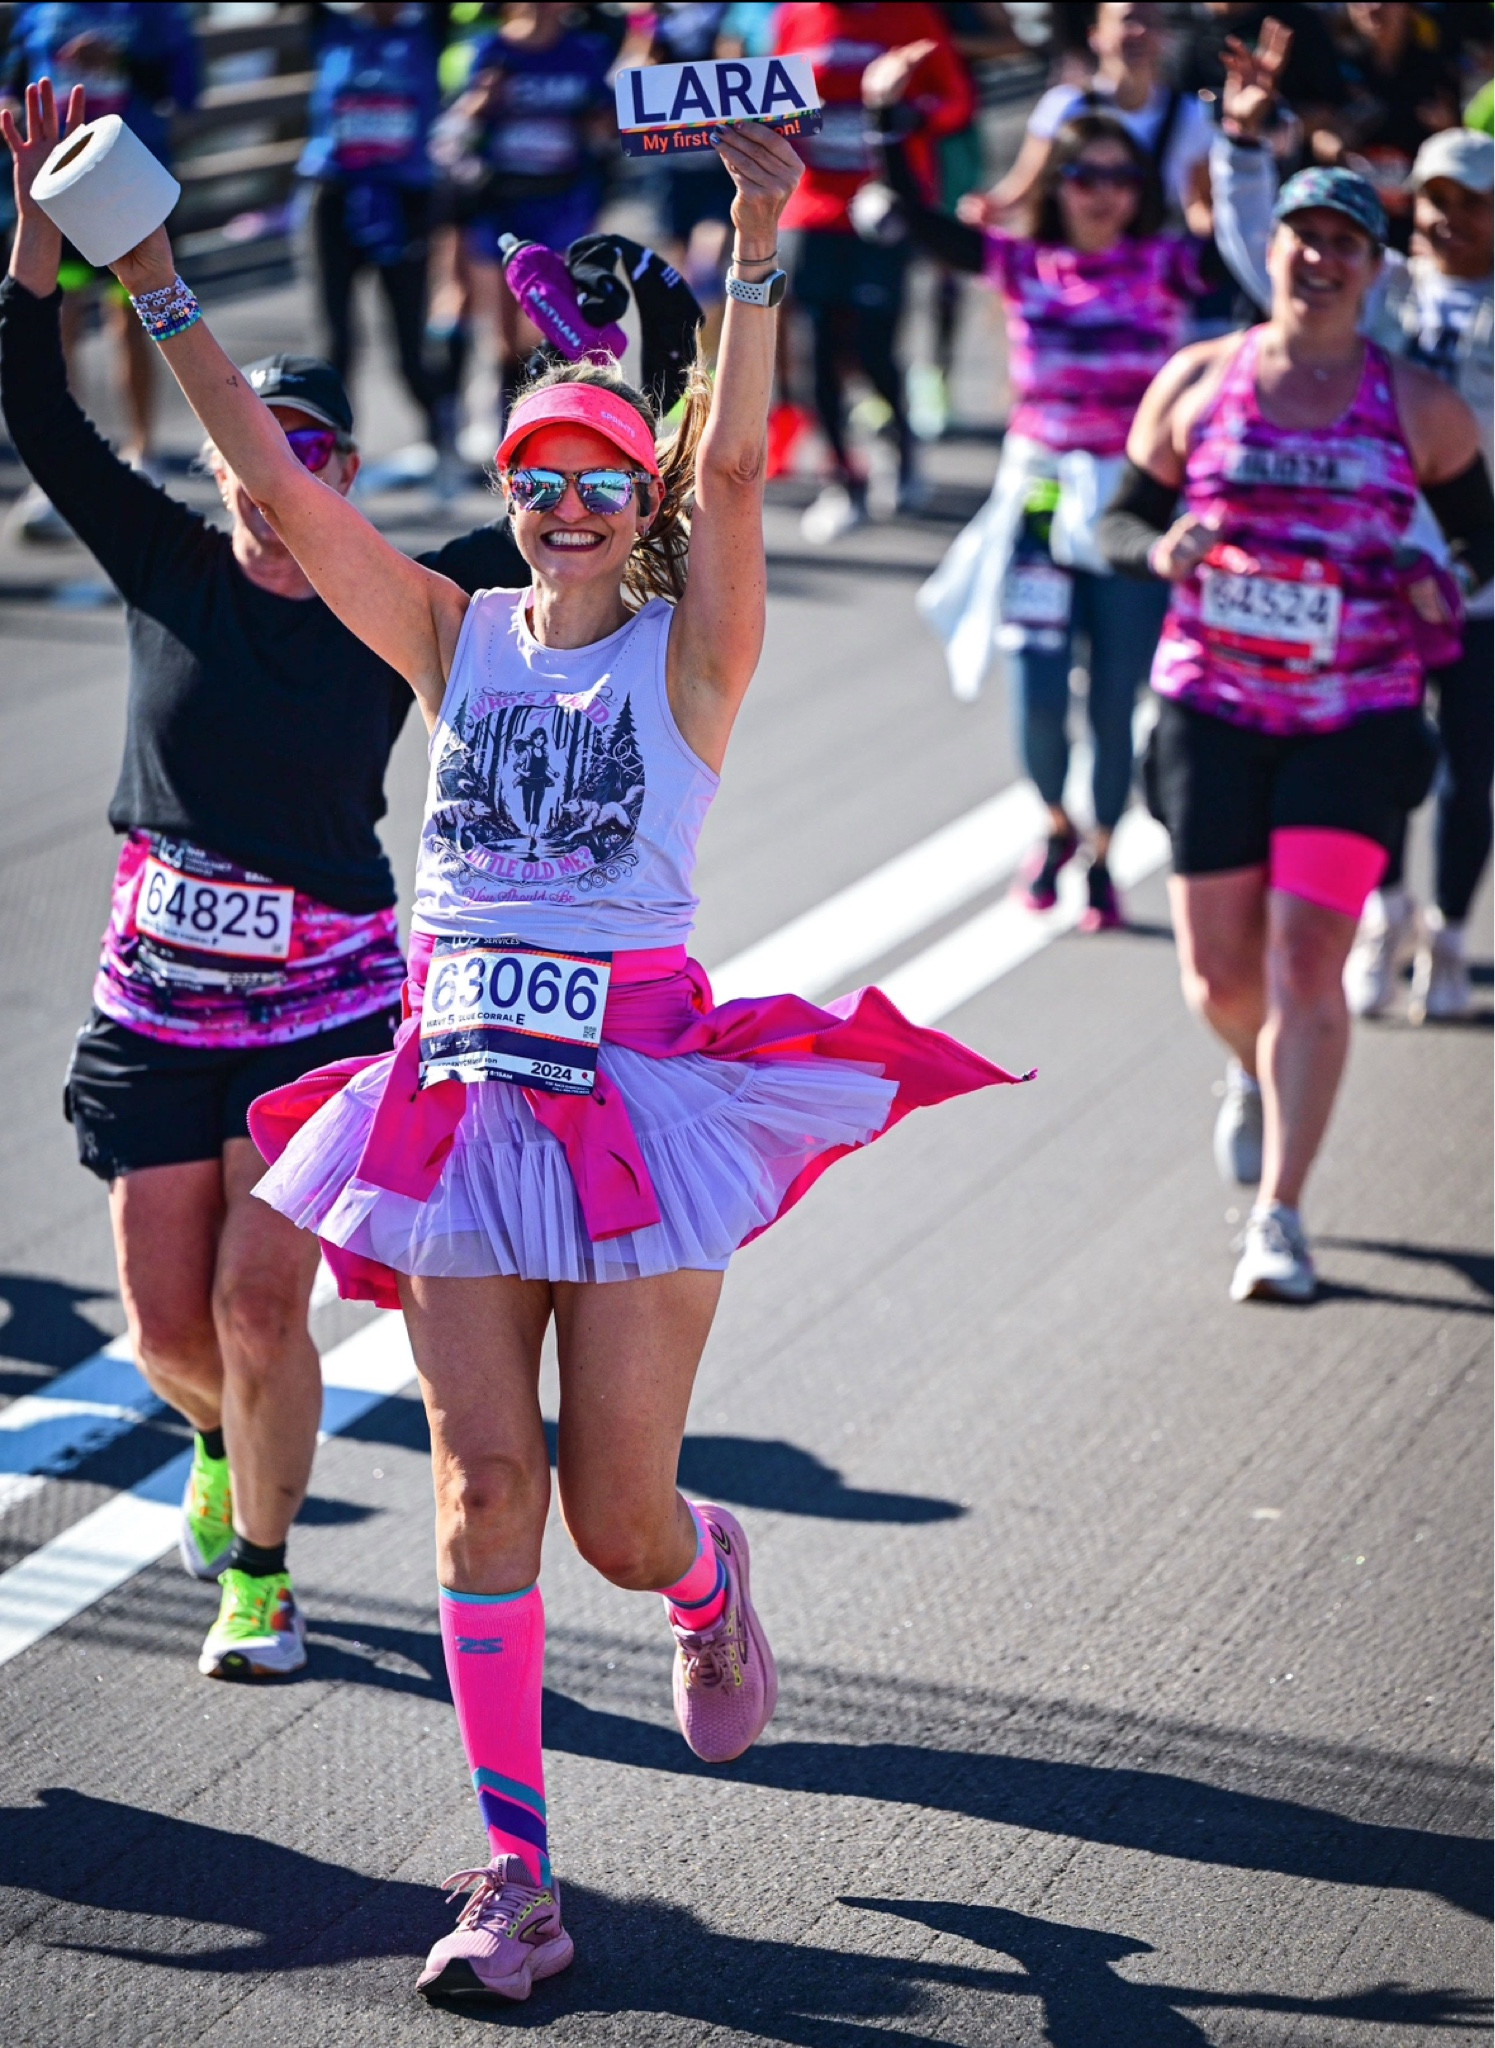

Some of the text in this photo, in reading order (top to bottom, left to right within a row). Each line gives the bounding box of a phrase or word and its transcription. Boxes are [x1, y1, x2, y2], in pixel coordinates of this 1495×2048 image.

[630, 59, 807, 124] LARA
[643, 131, 710, 153] My first
[527, 286, 581, 347] NATHAN
[470, 693, 611, 724] WHO'S ARID
[465, 843, 595, 881] LITTLE OLD ME?
[146, 871, 280, 940] 64825
[462, 886, 494, 906] You
[483, 937, 520, 945] SERVICES
[431, 956, 600, 1021] 63066
[477, 1012, 515, 1023] CORRAL
[516, 1013, 526, 1026] E
[530, 1061, 572, 1082] 2024
